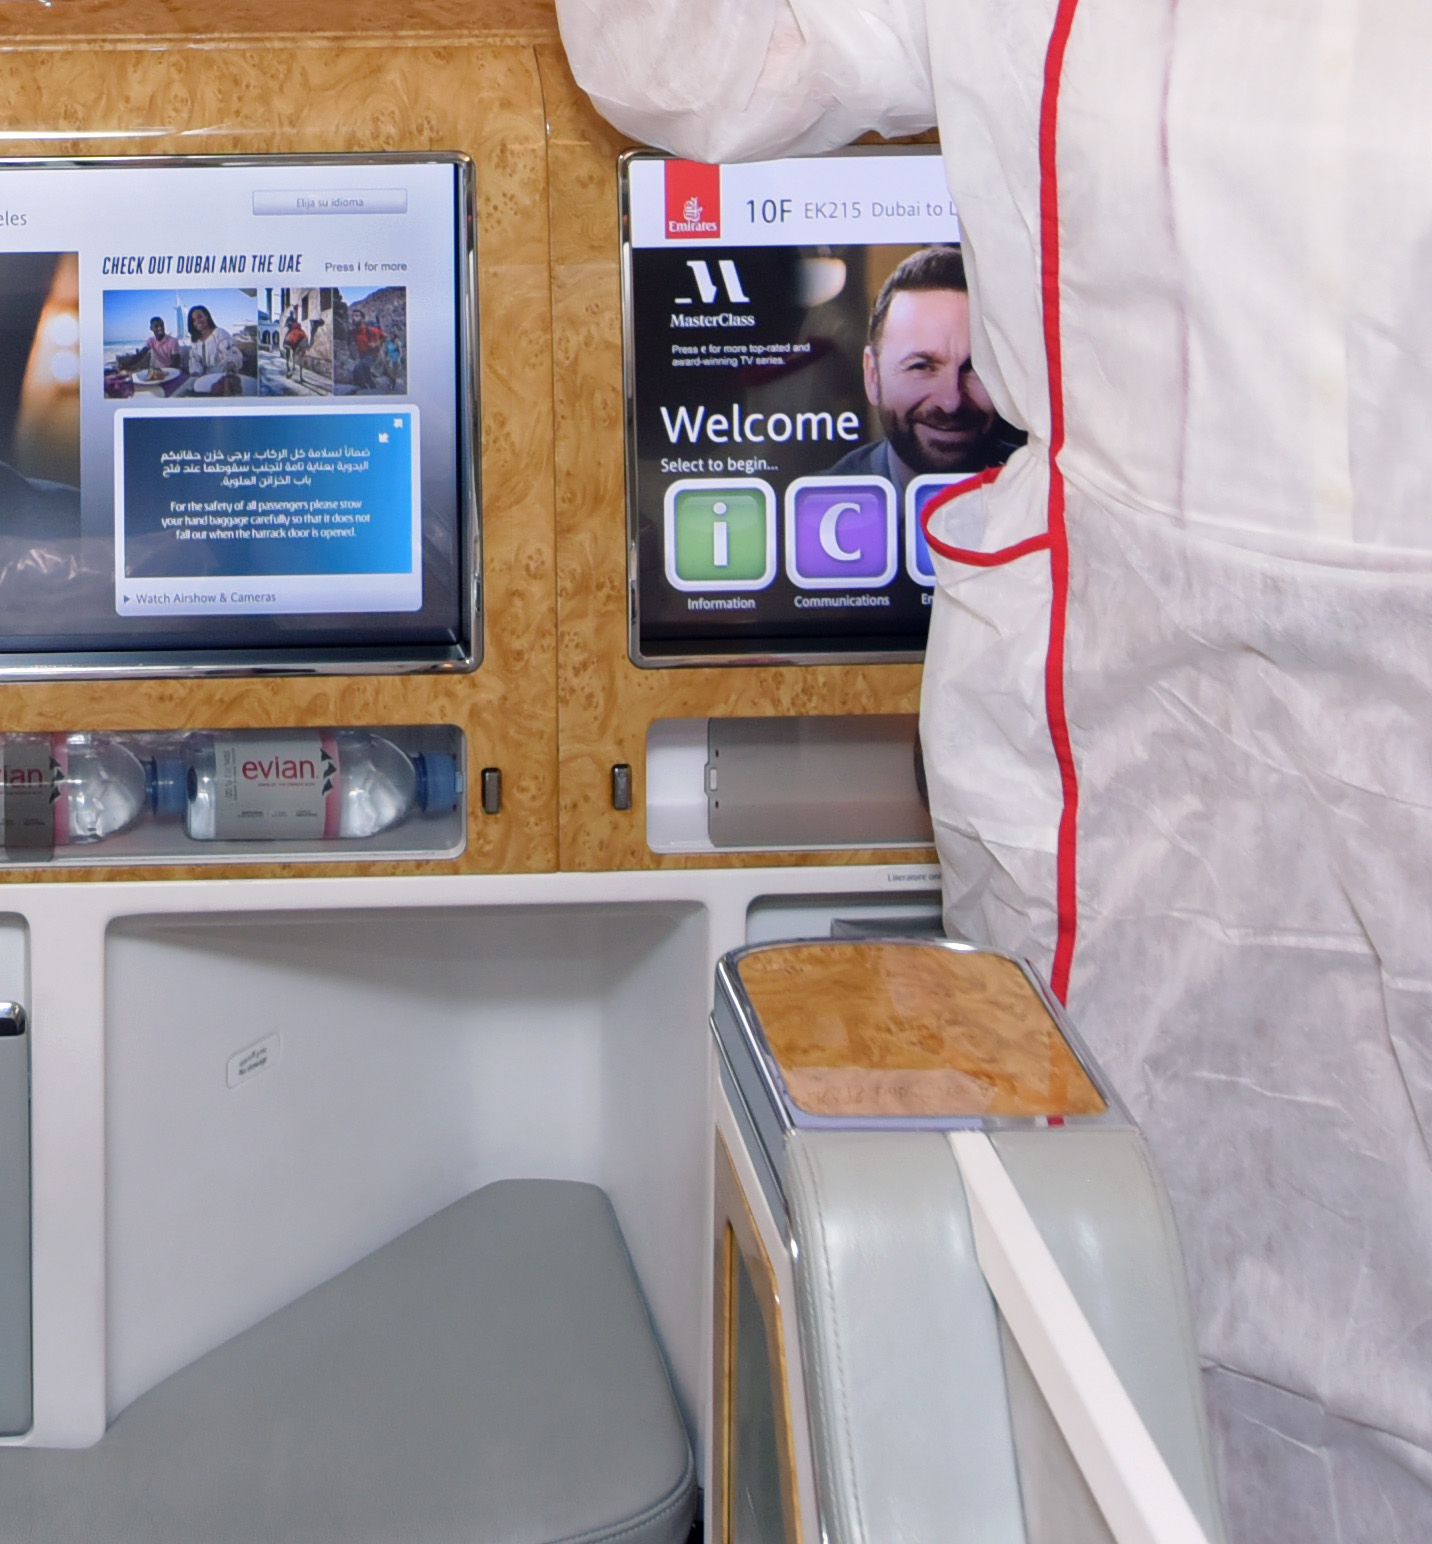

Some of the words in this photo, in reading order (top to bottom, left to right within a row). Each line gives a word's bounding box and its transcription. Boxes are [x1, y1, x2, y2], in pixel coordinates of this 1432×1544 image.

[297, 199, 315, 210] Elija
[331, 198, 364, 207] idioma
[746, 199, 792, 223] 10F
[804, 201, 861, 218] EK215
[872, 201, 920, 216] Dubai
[926, 202, 942, 216] to
[668, 221, 717, 232] Emirates
[102, 256, 144, 274] CHECK
[147, 256, 173, 274] OUT
[176, 255, 216, 273] DUBAI
[219, 255, 246, 272] AND
[250, 254, 274, 272] THE
[277, 254, 302, 272] UAE
[324, 262, 354, 272] Press
[364, 261, 378, 271] for
[380, 263, 407, 271] more
[670, 312, 754, 327] MasterClass
[672, 345, 697, 354] Press
[709, 344, 720, 353] for
[749, 343, 790, 355] top-rated
[793, 342, 809, 352] and
[672, 357, 737, 369] award-winning
[740, 356, 752, 365] TV
[660, 402, 858, 442] Welcome
[660, 457, 704, 472] Select
[708, 458, 723, 471] to
[170, 501, 186, 511] For
[187, 501, 202, 511] the
[204, 500, 232, 514] safety
[234, 500, 244, 510] of
[246, 500, 256, 510] all
[258, 502, 308, 512] passengers
[310, 499, 338, 512] please
[340, 498, 361, 508] stow
[161, 517, 183, 528] your
[184, 514, 207, 524] hand
[209, 514, 248, 527] baggage
[250, 513, 290, 526] carefully
[292, 515, 302, 523] so
[304, 513, 322, 523] that
[324, 513, 329, 522] it
[332, 512, 353, 522] does
[355, 512, 369, 522] not
[176, 528, 190, 538] fall
[191, 528, 207, 538] out
[208, 527, 234, 538] when
[235, 527, 250, 538] the
[287, 526, 310, 537] door
[311, 526, 318, 536] is
[713, 502, 727, 566] i
[819, 502, 860, 560] c
[136, 593, 170, 604] Watch
[173, 592, 216, 603] Airshow
[230, 592, 275, 603] Cameras
[687, 596, 755, 609] Information
[794, 594, 889, 607] Communications
[241, 757, 315, 780] evian
